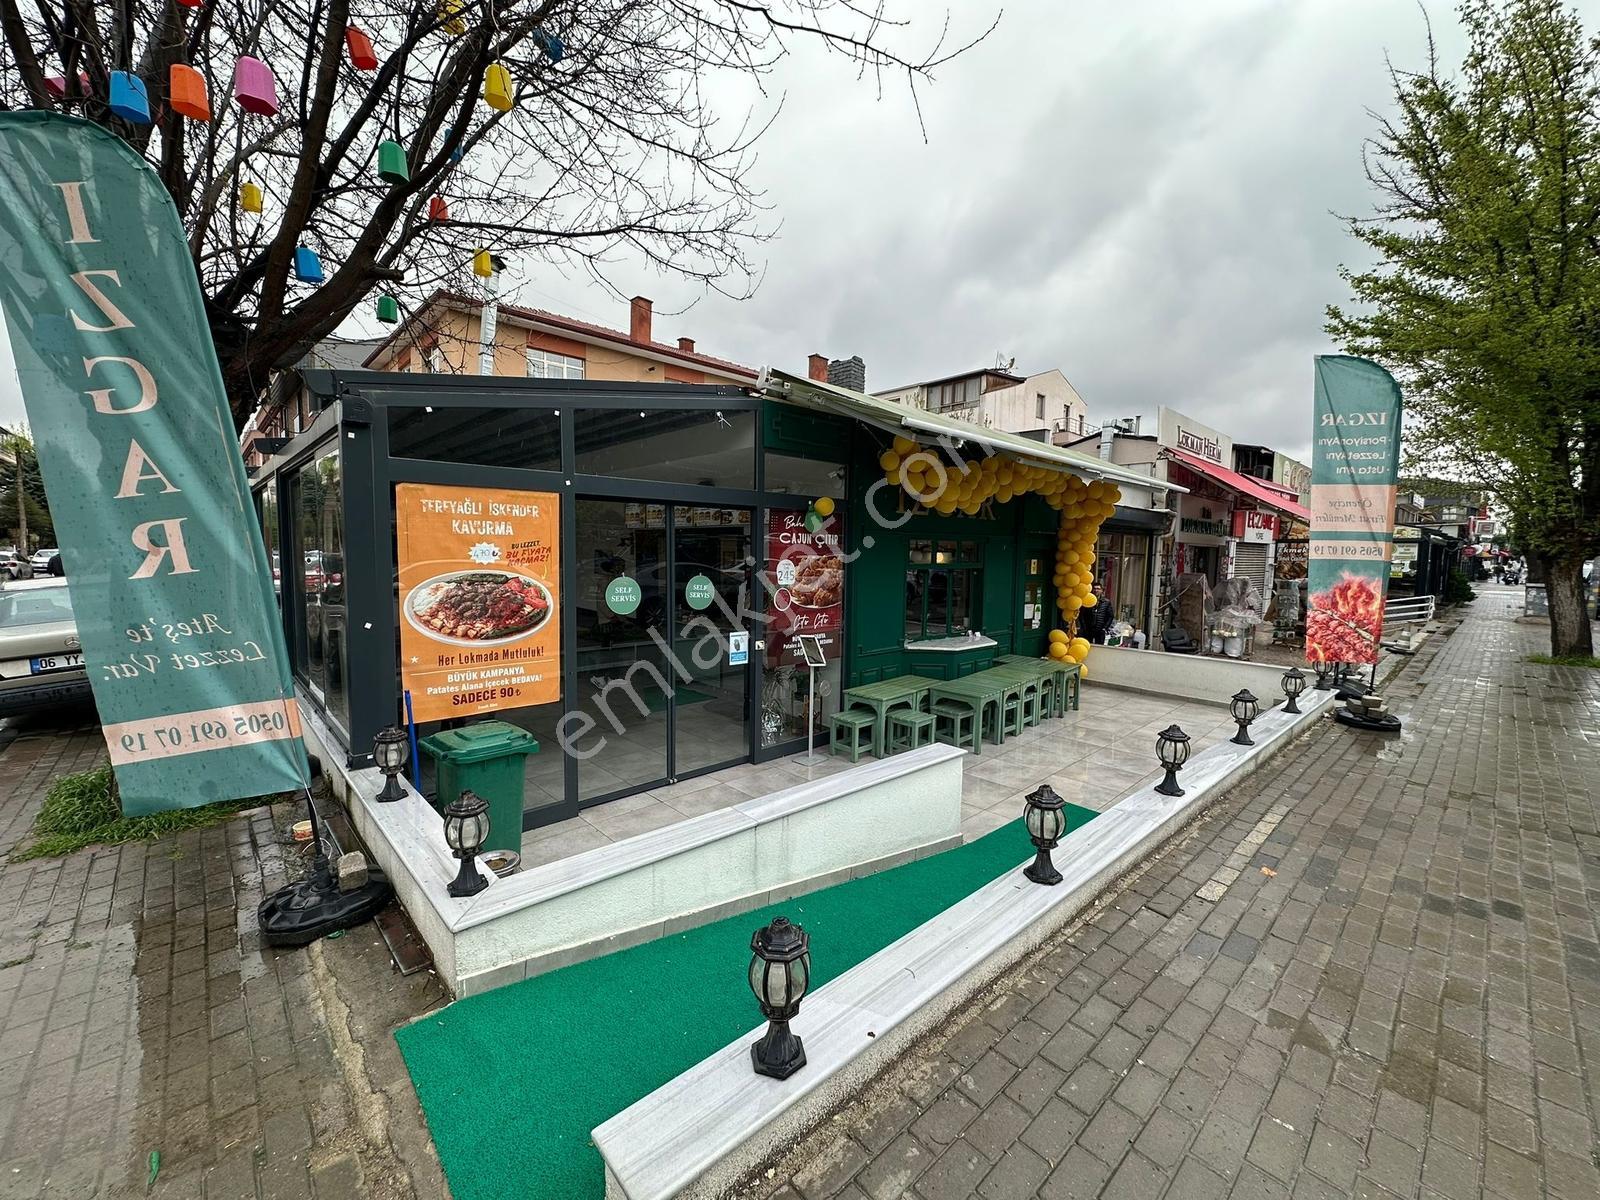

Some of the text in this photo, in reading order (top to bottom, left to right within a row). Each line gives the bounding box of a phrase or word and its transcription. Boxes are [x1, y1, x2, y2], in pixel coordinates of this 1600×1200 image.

[419, 497, 539, 518] TEREYAĞLI İSKENDER
[452, 519, 514, 536] KAVURMA
[1247, 511, 1274, 530] ECZANE
[779, 532, 839, 548] CAJUN ÇITIR
[611, 594, 637, 602] SERVİS
[614, 586, 633, 594] SELF
[40, 657, 56, 669] 06
[438, 646, 544, 667] Her Lokmada Mutluluk!
[447, 666, 525, 683] BÜYÜK KAMPANYA
[427, 685, 459, 695] Patates
[461, 682, 484, 692] Alana
[511, 673, 543, 685] BEDAVA!
[452, 689, 497, 706] SADECE
